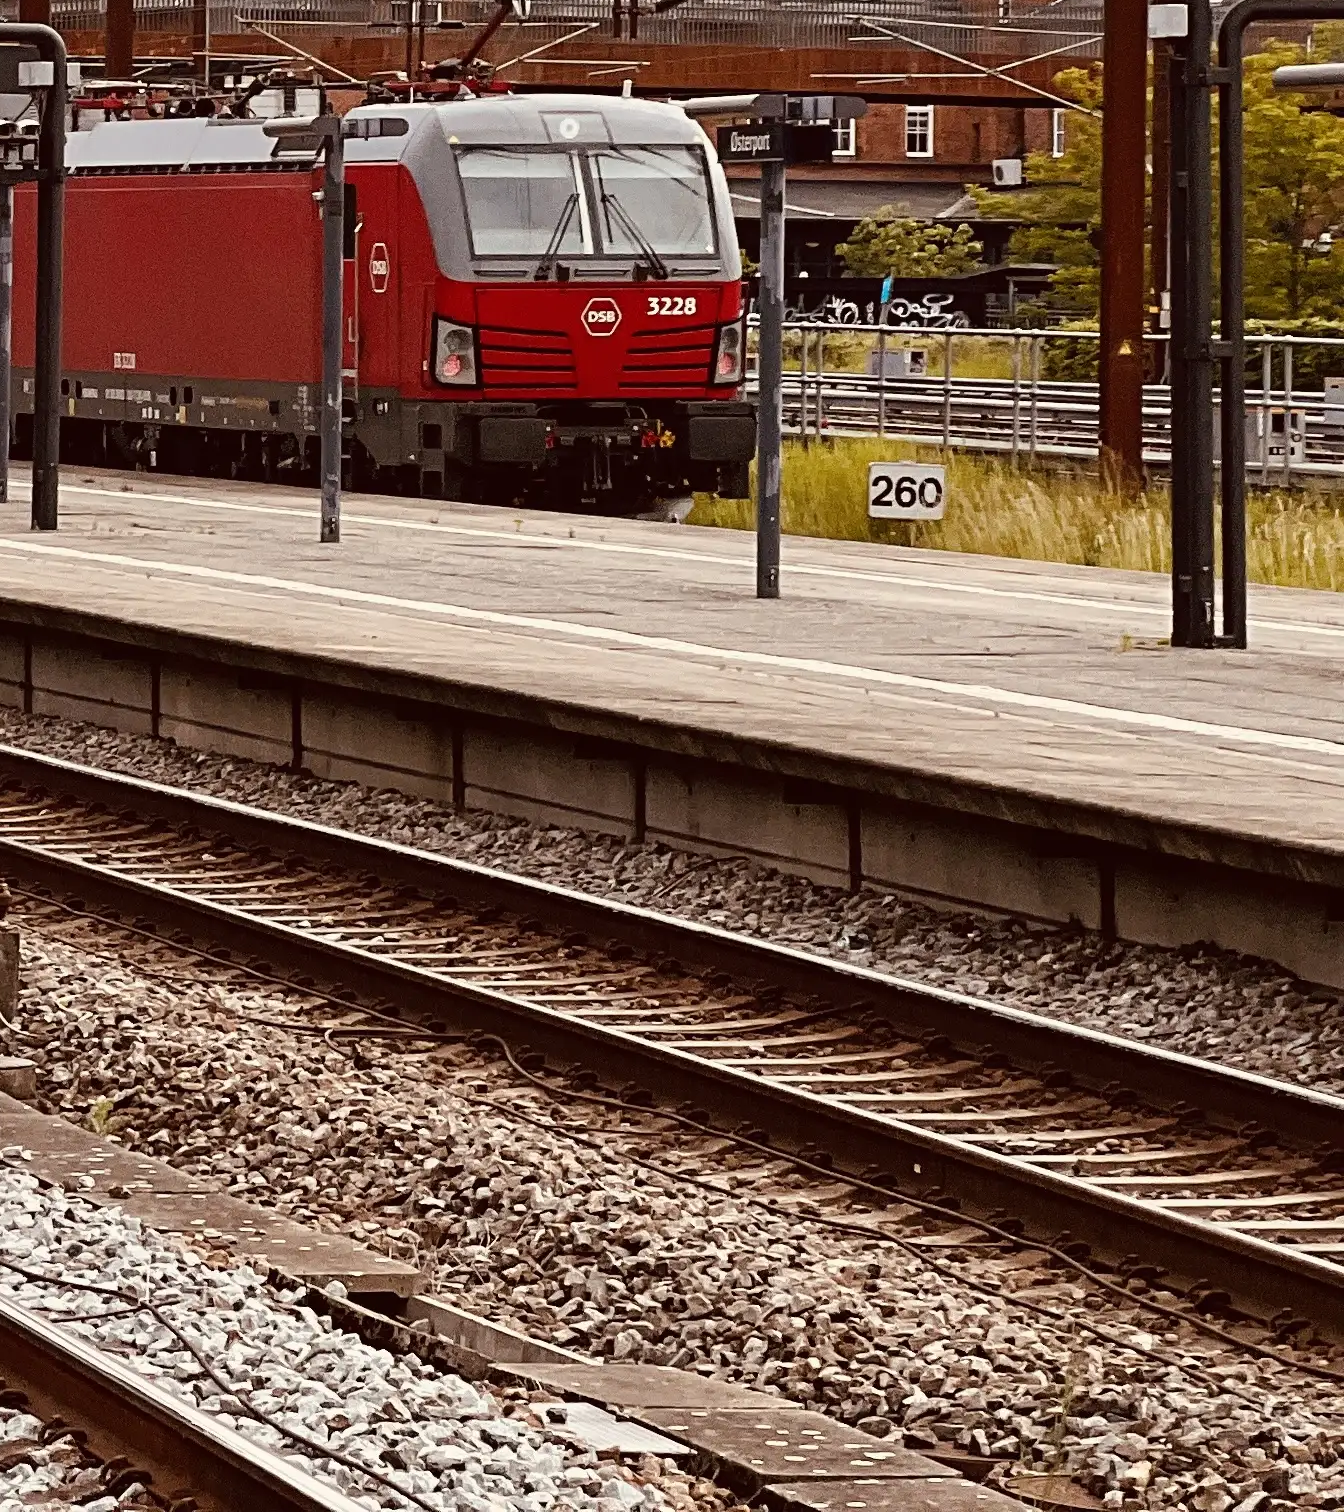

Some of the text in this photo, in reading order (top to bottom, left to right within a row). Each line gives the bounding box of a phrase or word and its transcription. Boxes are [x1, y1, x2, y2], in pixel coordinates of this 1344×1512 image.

[730, 131, 771, 156] Østerport
[372, 260, 387, 275] DSB
[646, 296, 697, 316] 3228
[587, 310, 616, 323] DSB
[871, 475, 943, 509] 260
